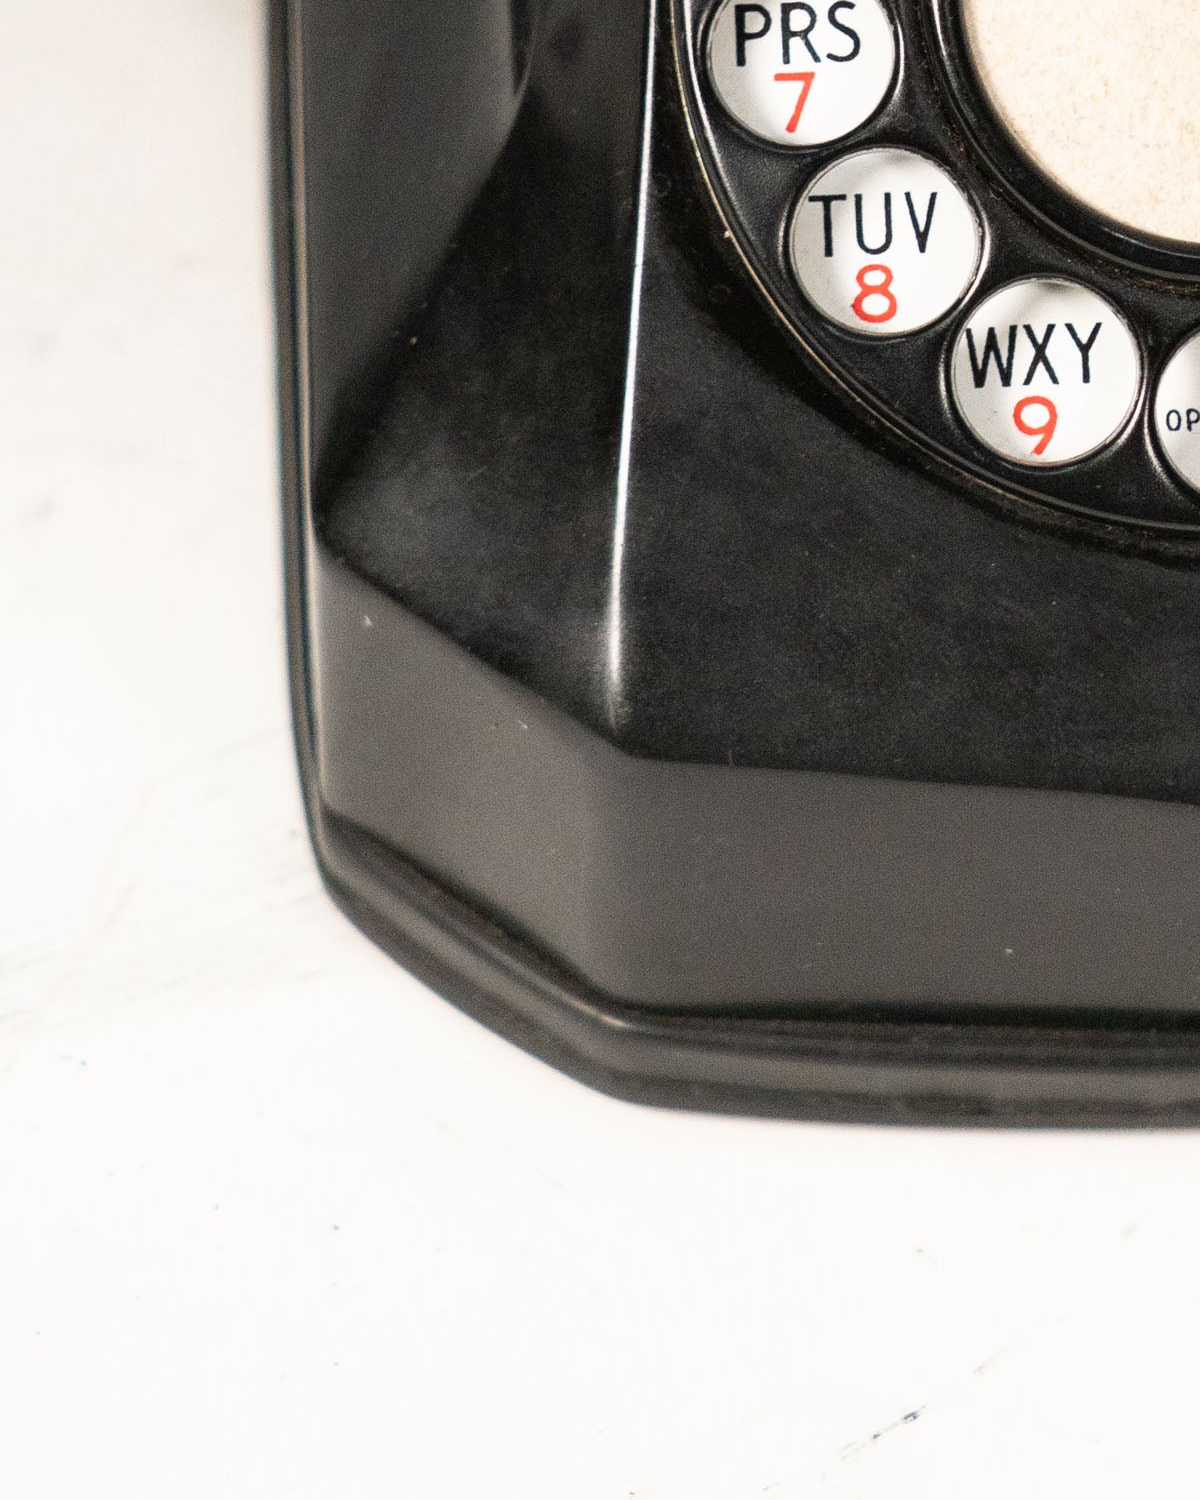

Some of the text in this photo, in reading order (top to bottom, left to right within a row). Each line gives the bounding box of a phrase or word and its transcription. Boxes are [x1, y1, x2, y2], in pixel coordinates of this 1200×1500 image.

[733, 0, 862, 68] PRS
[773, 71, 816, 134] 7
[807, 190, 938, 258] TUV
[851, 263, 898, 324] 8
[964, 321, 1103, 389] WXY
[1012, 395, 1058, 456] 9
